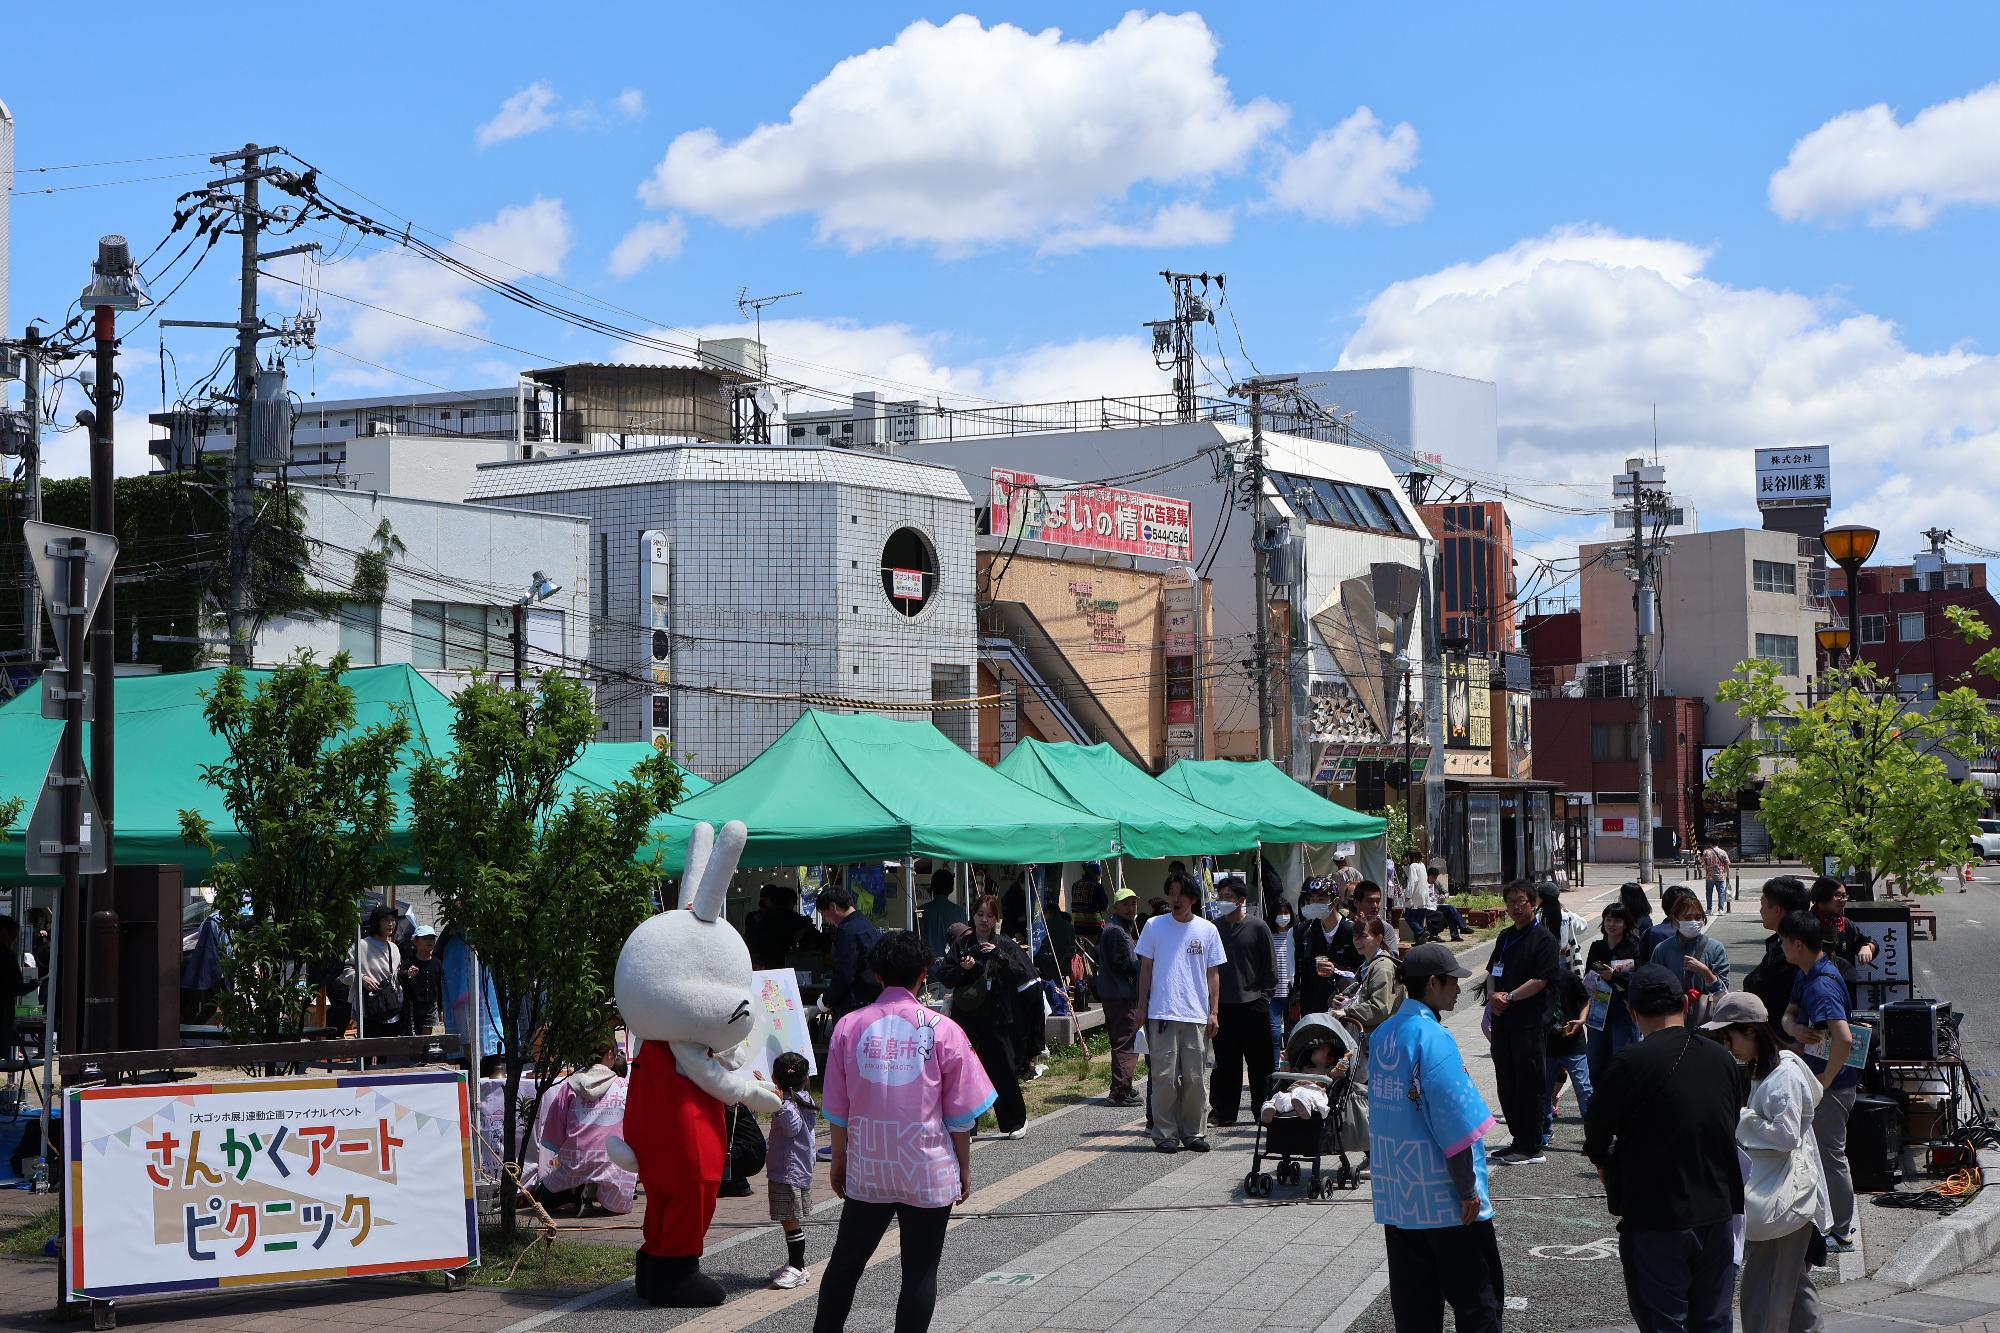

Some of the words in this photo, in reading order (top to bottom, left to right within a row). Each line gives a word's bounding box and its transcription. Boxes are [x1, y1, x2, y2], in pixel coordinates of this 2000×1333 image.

[1770, 454, 1813, 465] 株式会社
[1761, 473, 1826, 493] 長谷川産業
[1143, 503, 1188, 528] 広告募集
[863, 1036, 920, 1060] 福島市
[1372, 1073, 1405, 1102] 福島市
[189, 1107, 362, 1124] 「大ゴッホ展」連動企画ファイナルイベント
[145, 1118, 404, 1188] さんかくアート
[186, 1193, 372, 1262] ピクニック
